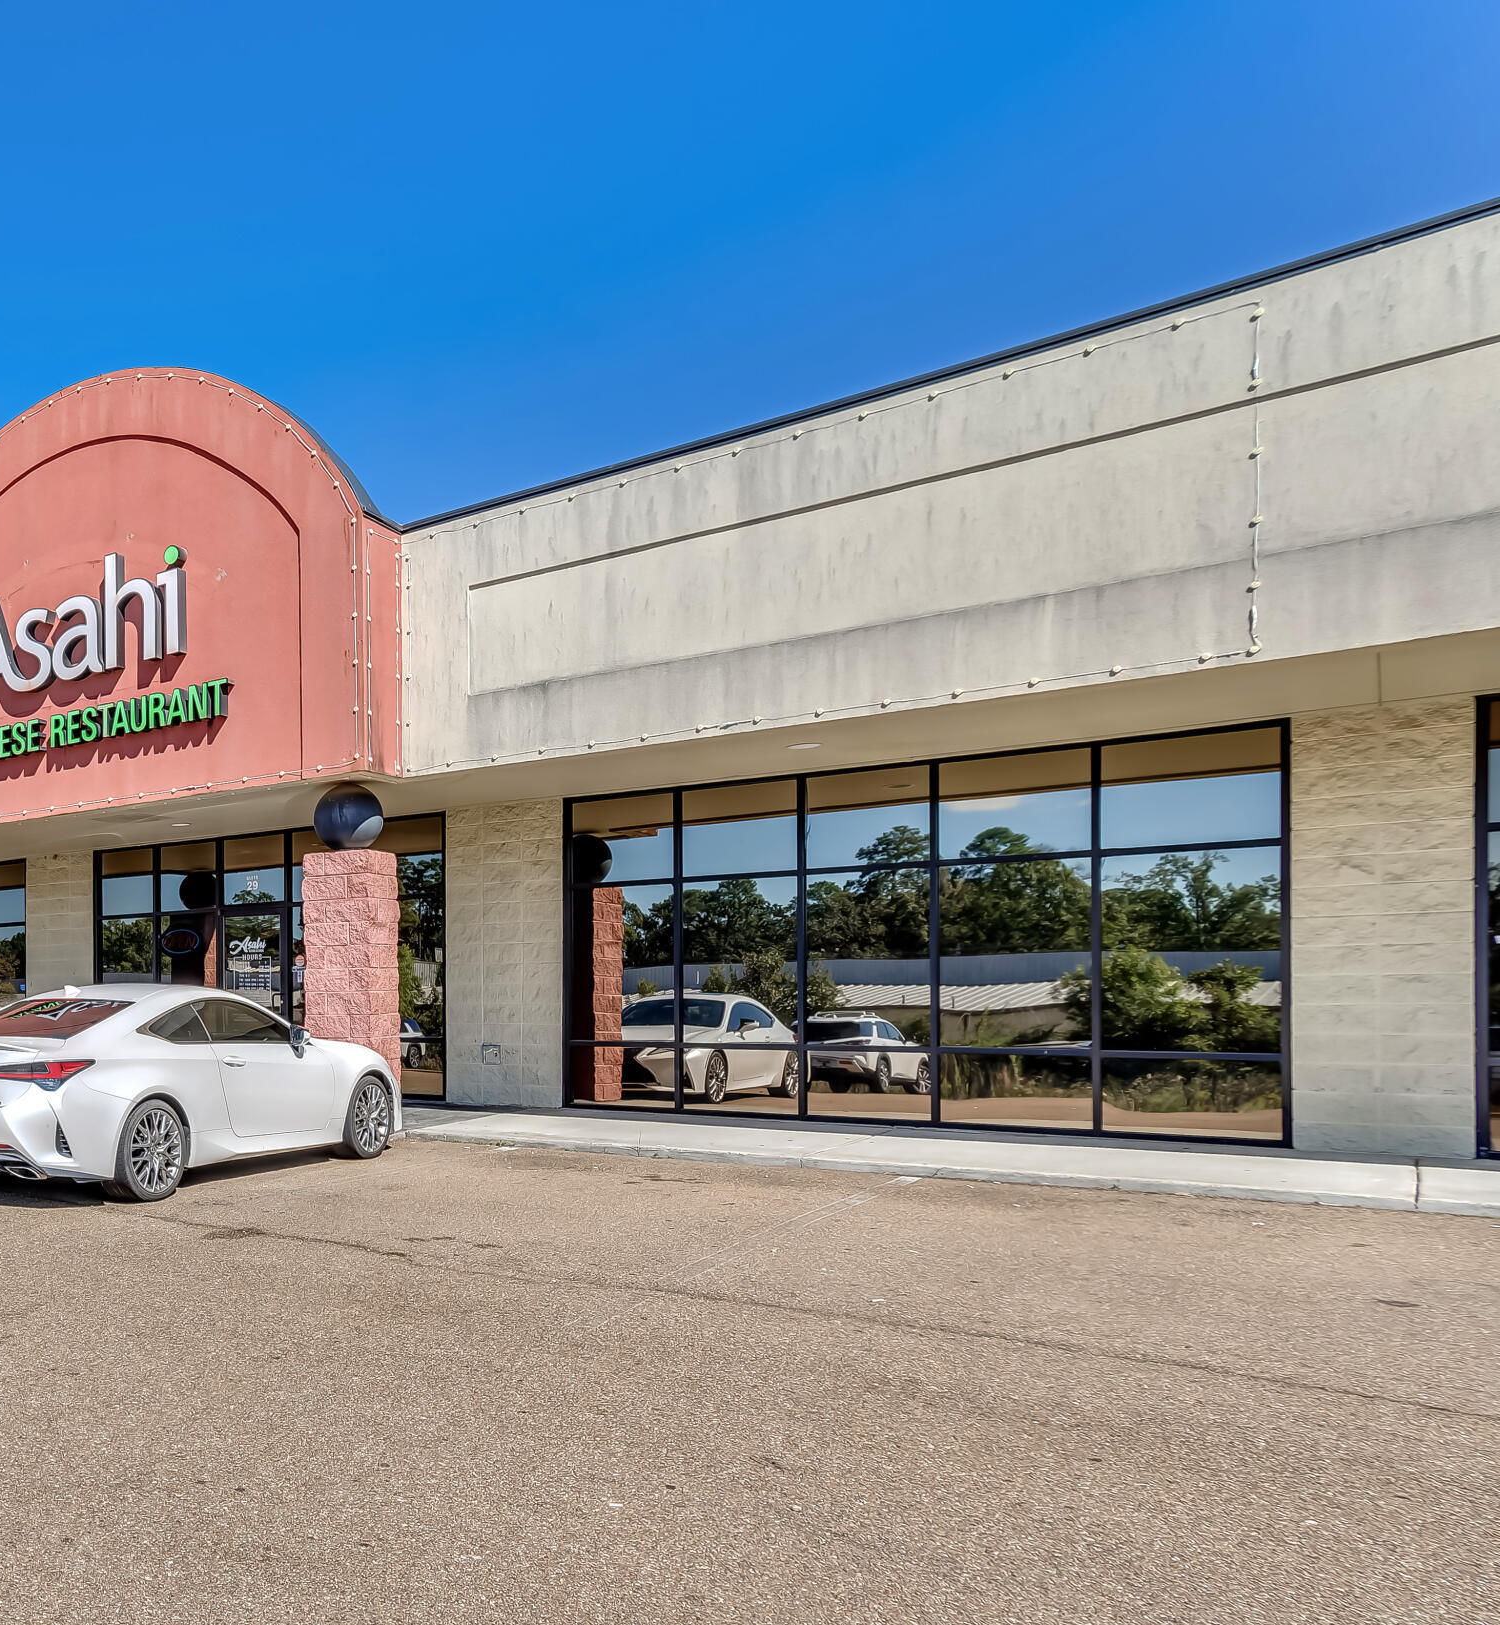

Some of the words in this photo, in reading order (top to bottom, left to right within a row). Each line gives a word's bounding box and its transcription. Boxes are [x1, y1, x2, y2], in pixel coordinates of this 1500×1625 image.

[50, 677, 233, 749] RESTAURANT
[246, 880, 259, 891] 29
[229, 936, 266, 955] Asahi
